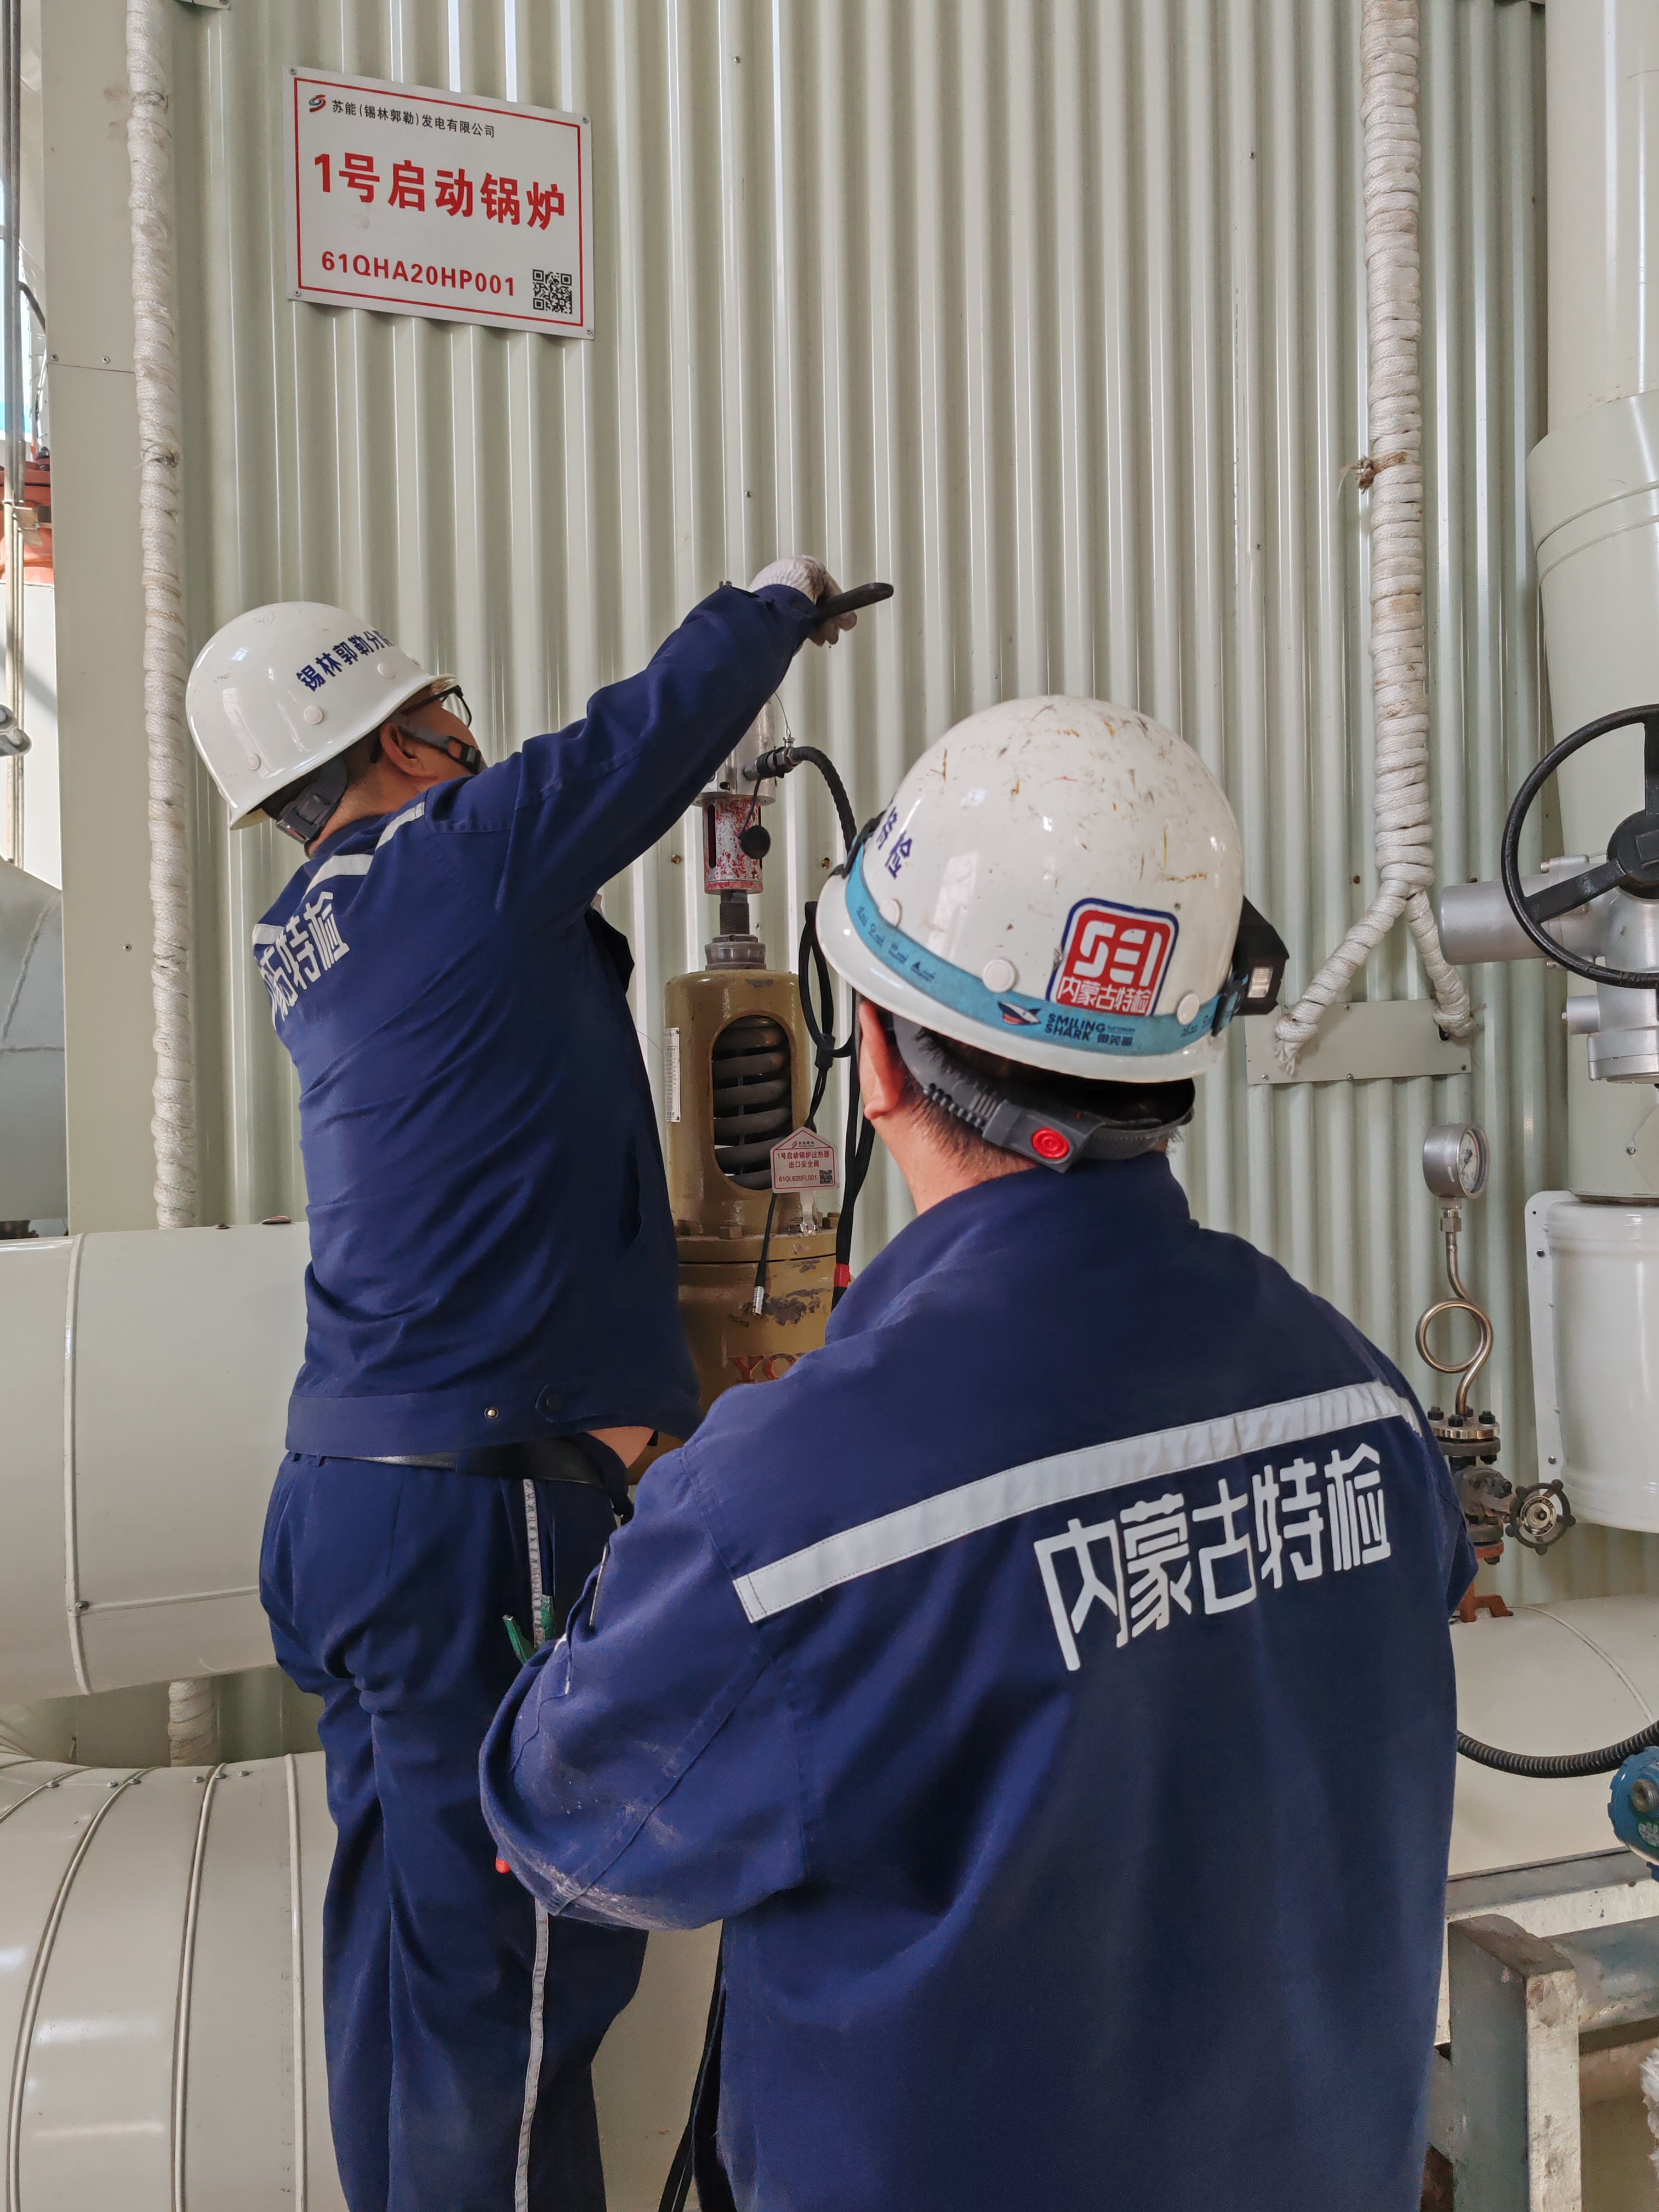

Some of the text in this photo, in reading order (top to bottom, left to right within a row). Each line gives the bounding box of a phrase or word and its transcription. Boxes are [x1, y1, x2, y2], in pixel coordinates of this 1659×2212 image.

[314, 152, 565, 231] 1号启动锅炉
[322, 250, 514, 296] 61QHA20HP001
[1057, 976, 1152, 1013] 内蒙古特检
[1044, 1024, 1091, 1041] SHARK
[1048, 1013, 1105, 1033] SMILING
[727, 1353, 808, 1384] YO
[1034, 1442, 1391, 1672] 内蒙古特检
